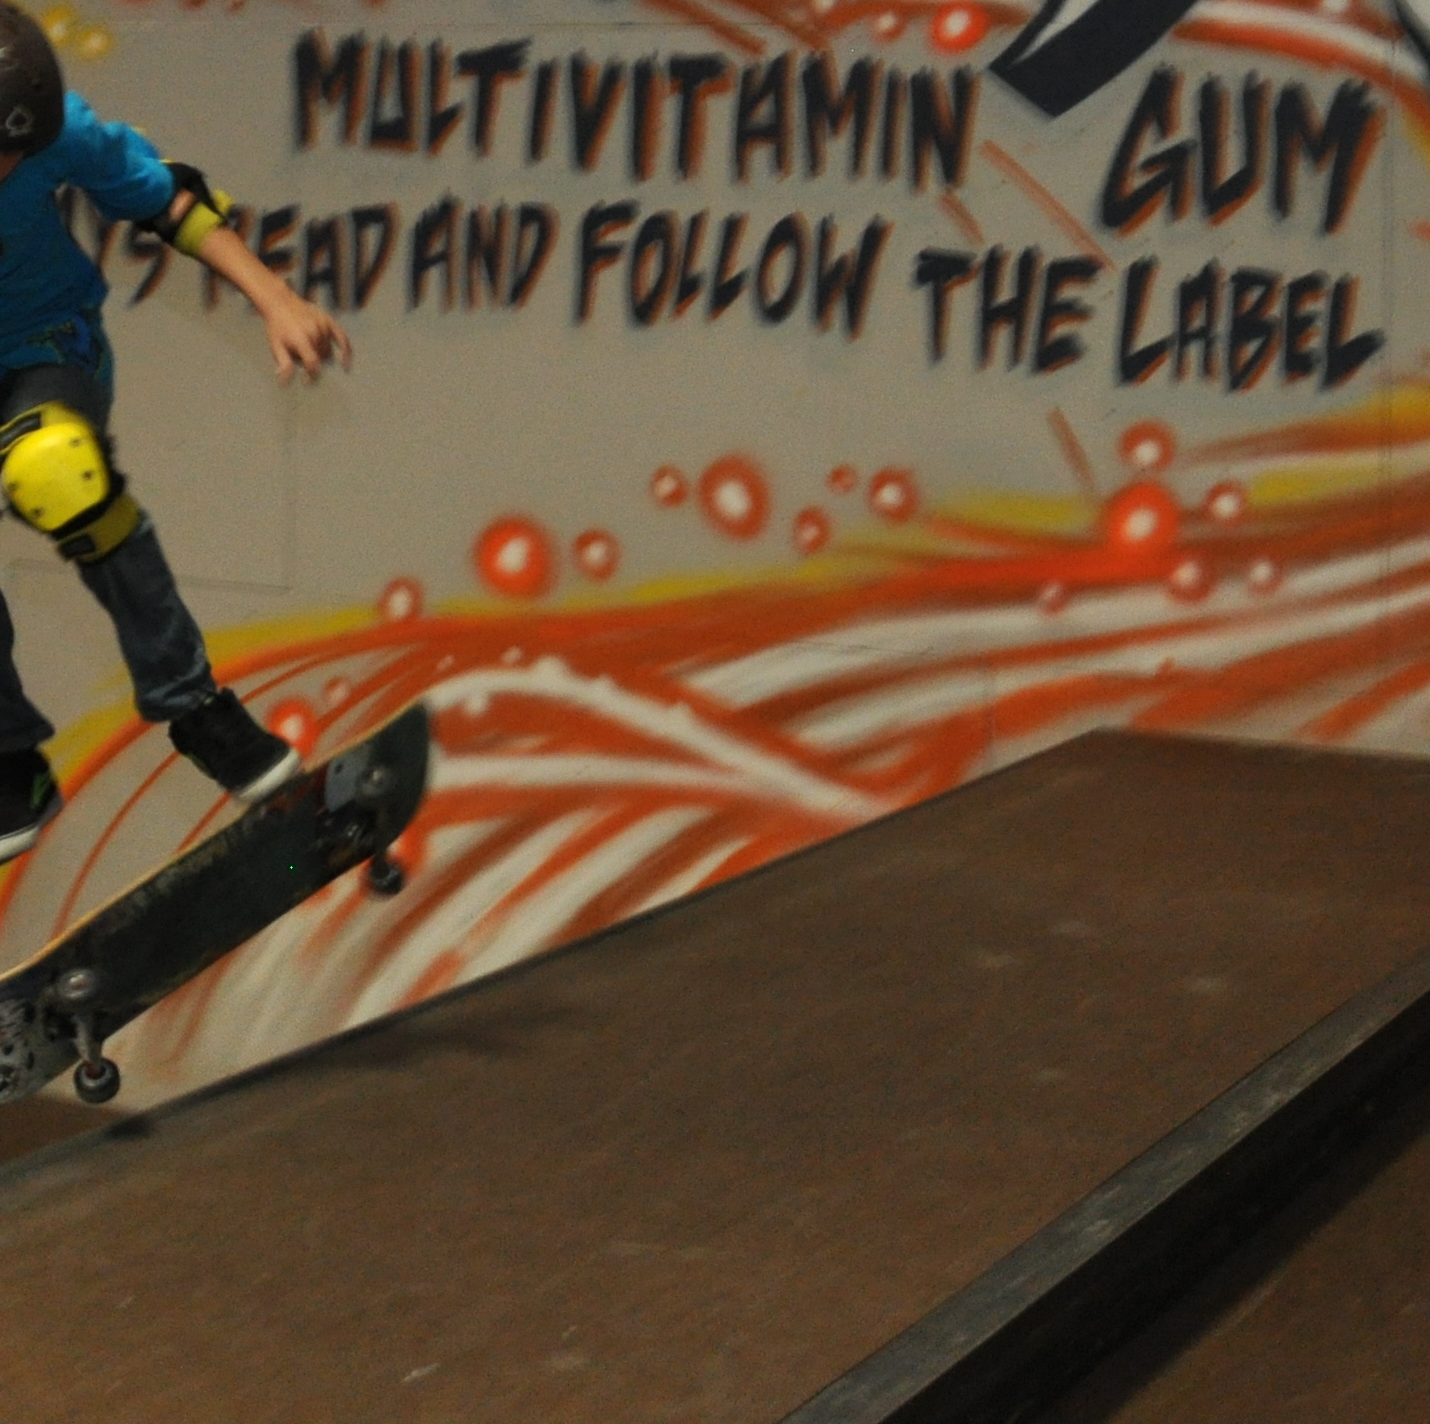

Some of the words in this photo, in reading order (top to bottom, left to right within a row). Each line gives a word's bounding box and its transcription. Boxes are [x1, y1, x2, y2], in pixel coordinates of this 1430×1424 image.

[291, 28, 977, 184] MULTIVITAMIN
[1097, 64, 1383, 236] GUM
[403, 191, 559, 312] AND
[569, 196, 889, 342] FOLLOW
[913, 244, 1097, 374] THE
[1113, 254, 1383, 390] LABEL
